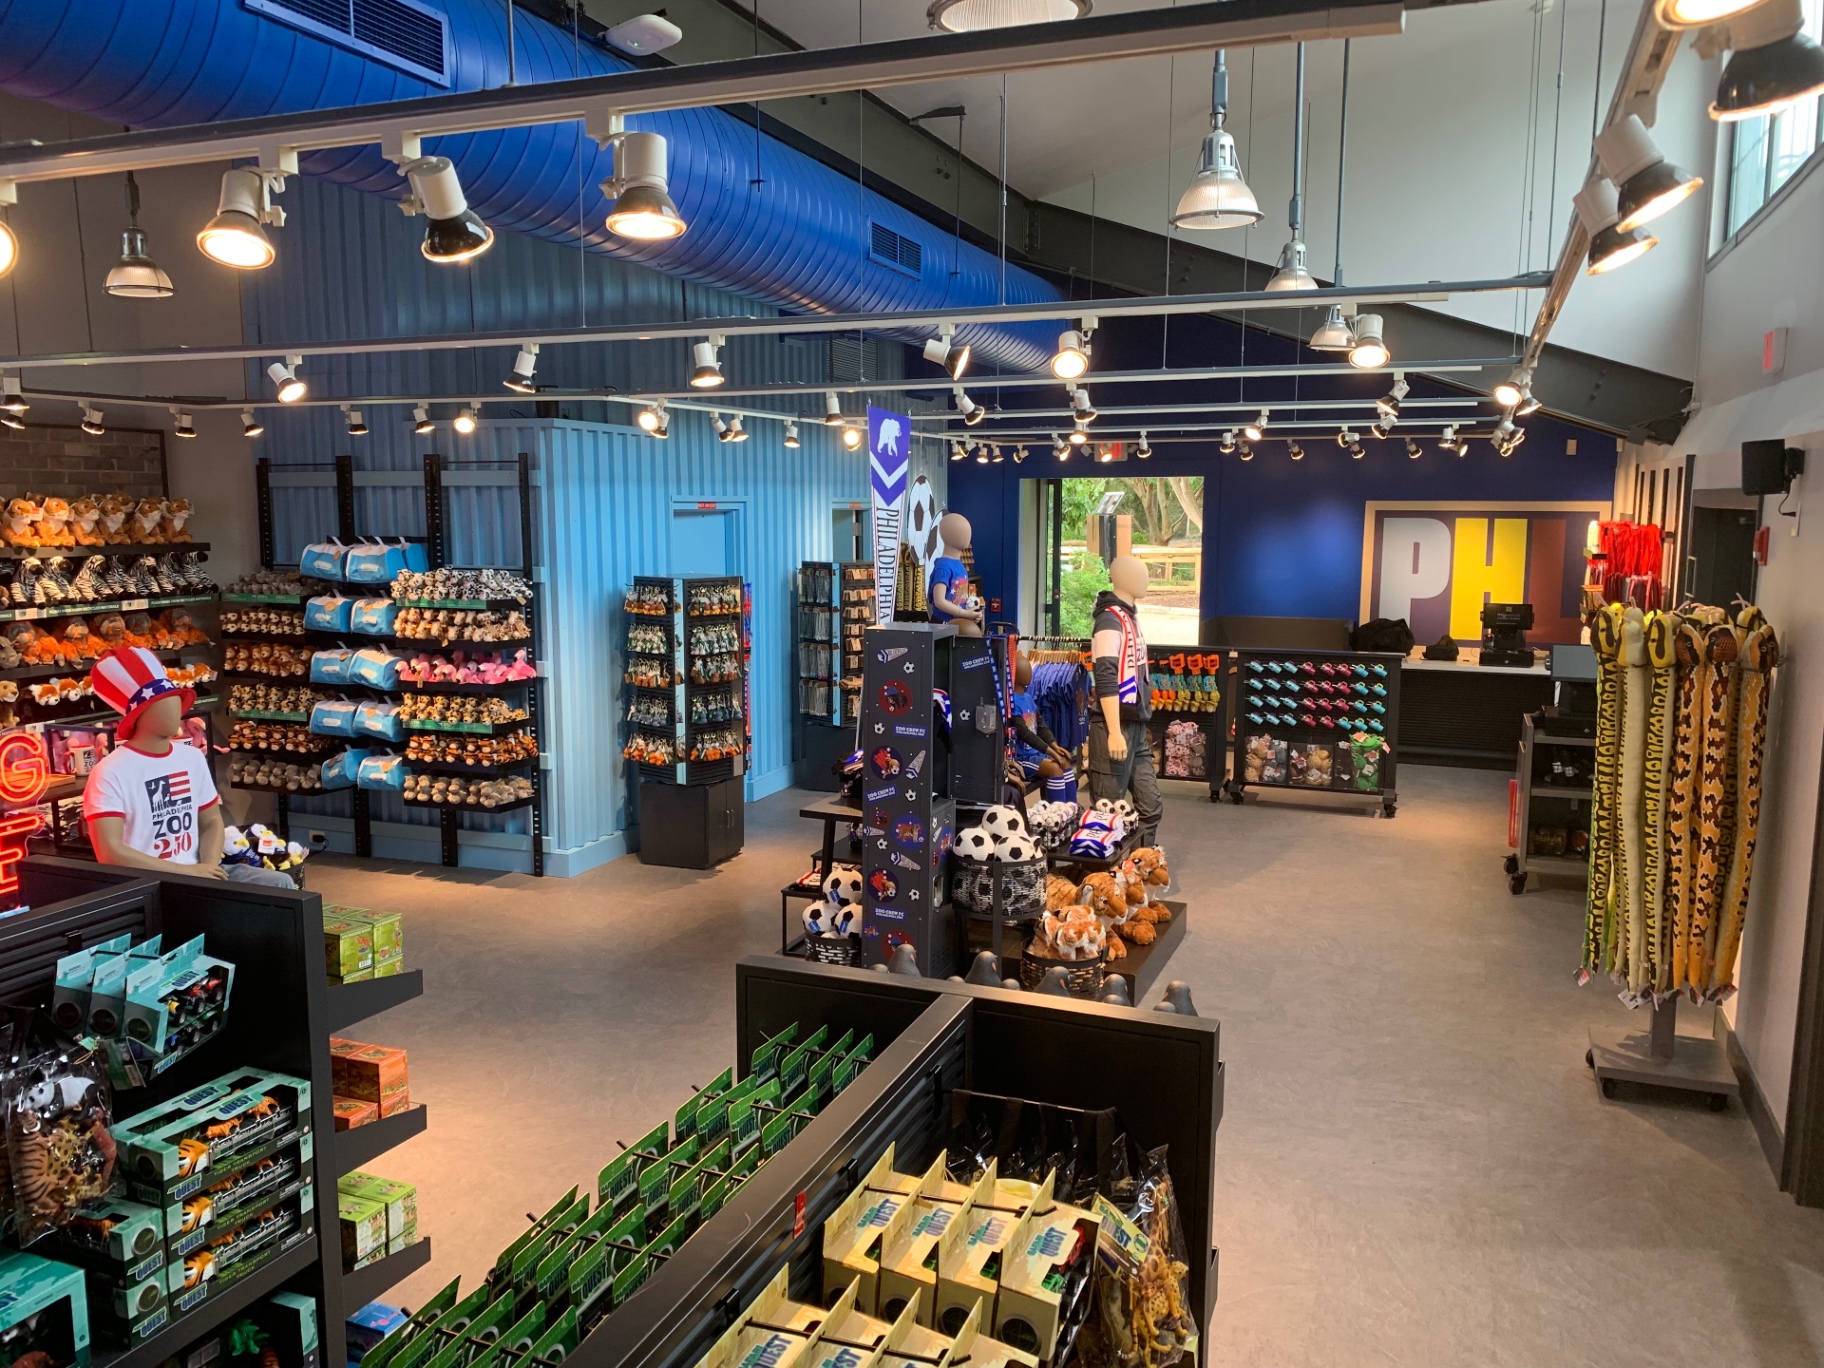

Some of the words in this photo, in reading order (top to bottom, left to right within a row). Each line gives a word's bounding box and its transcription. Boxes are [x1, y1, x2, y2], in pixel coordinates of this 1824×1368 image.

[876, 506, 900, 620] PHILADELPHIA
[1378, 517, 1588, 643] PHL
[152, 804, 193, 821] PHILADELPHIA
[152, 812, 193, 840] ZOO
[183, 1086, 220, 1106] QUEST
[218, 1094, 254, 1115] QUEST
[175, 1177, 202, 1199] QUEST
[869, 1198, 900, 1228] QUEST
[924, 1207, 955, 1237] QUEST
[179, 1231, 205, 1255] QUEST
[979, 1216, 1008, 1246] QUEST
[1039, 1226, 1068, 1258] QUEST
[1101, 1215, 1133, 1250] QUEST
[136, 1256, 163, 1281] QUEST
[181, 1286, 208, 1311] QUEST
[140, 1311, 167, 1337] QUEST
